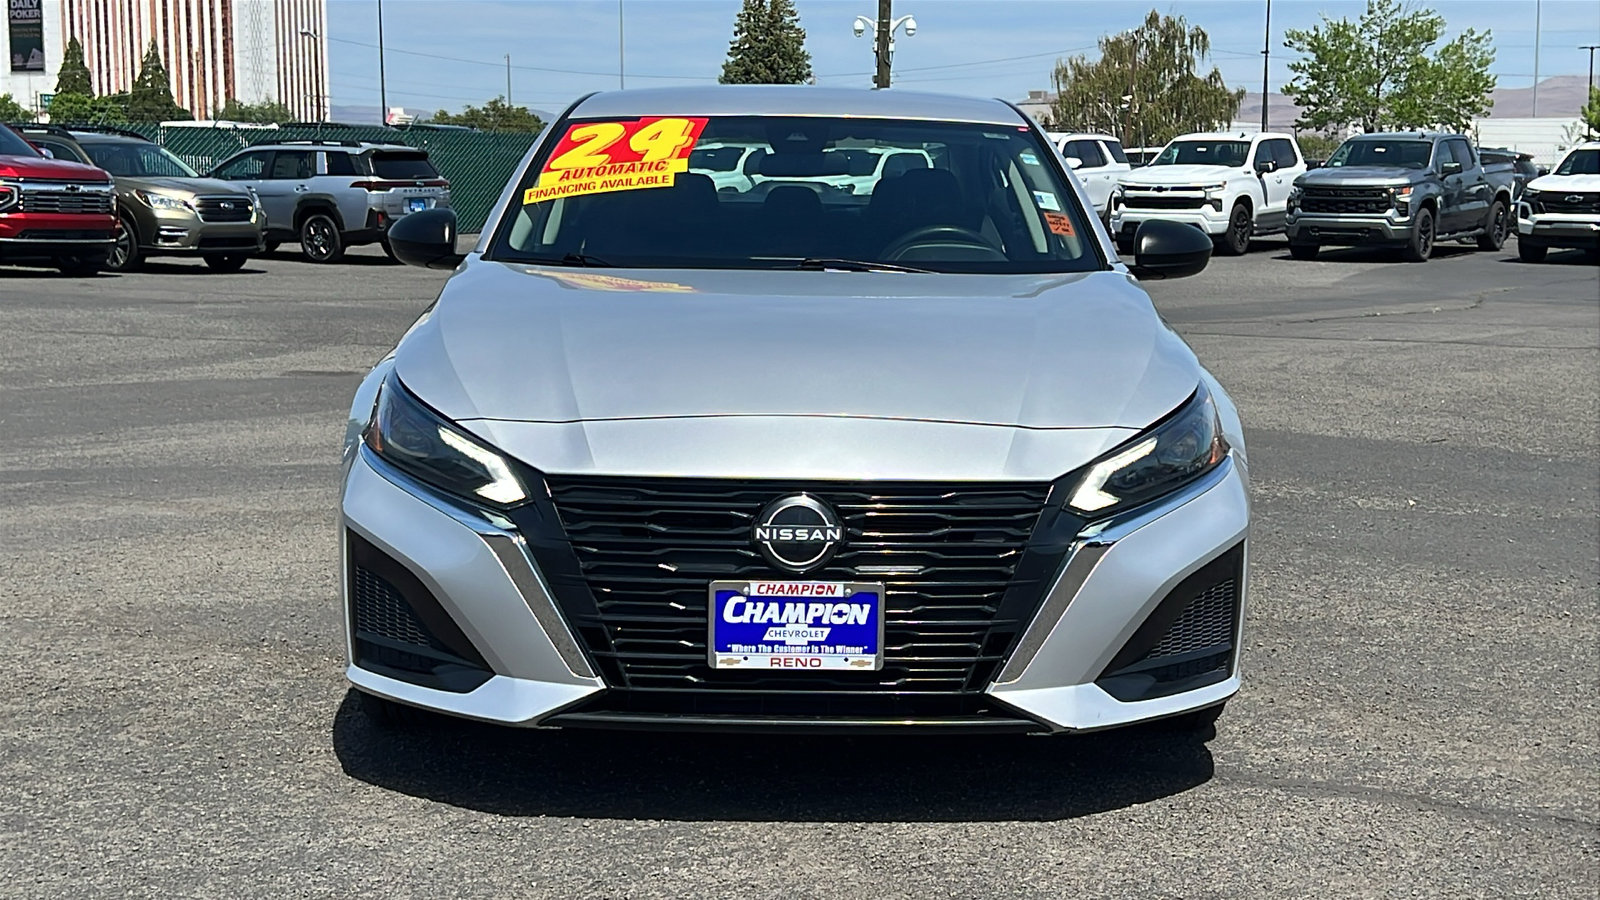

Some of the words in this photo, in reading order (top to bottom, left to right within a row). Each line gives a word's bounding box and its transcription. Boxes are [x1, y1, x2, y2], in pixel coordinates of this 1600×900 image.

[11, 0, 38, 8] DAILY
[10, 9, 41, 18] POKER
[550, 118, 696, 170] 24
[559, 160, 669, 182] AUTOMATIC
[528, 182, 597, 201] FINANCING
[599, 175, 670, 190] AVAILABLE
[756, 527, 840, 541] NISSAN
[757, 583, 837, 596] CHAMPION
[723, 595, 871, 625] CHAMPION
[768, 629, 825, 639] CHEVROLET
[758, 644, 772, 653] The
[774, 644, 810, 653] Customer
[820, 645, 835, 653] The
[770, 657, 822, 668] RENO
